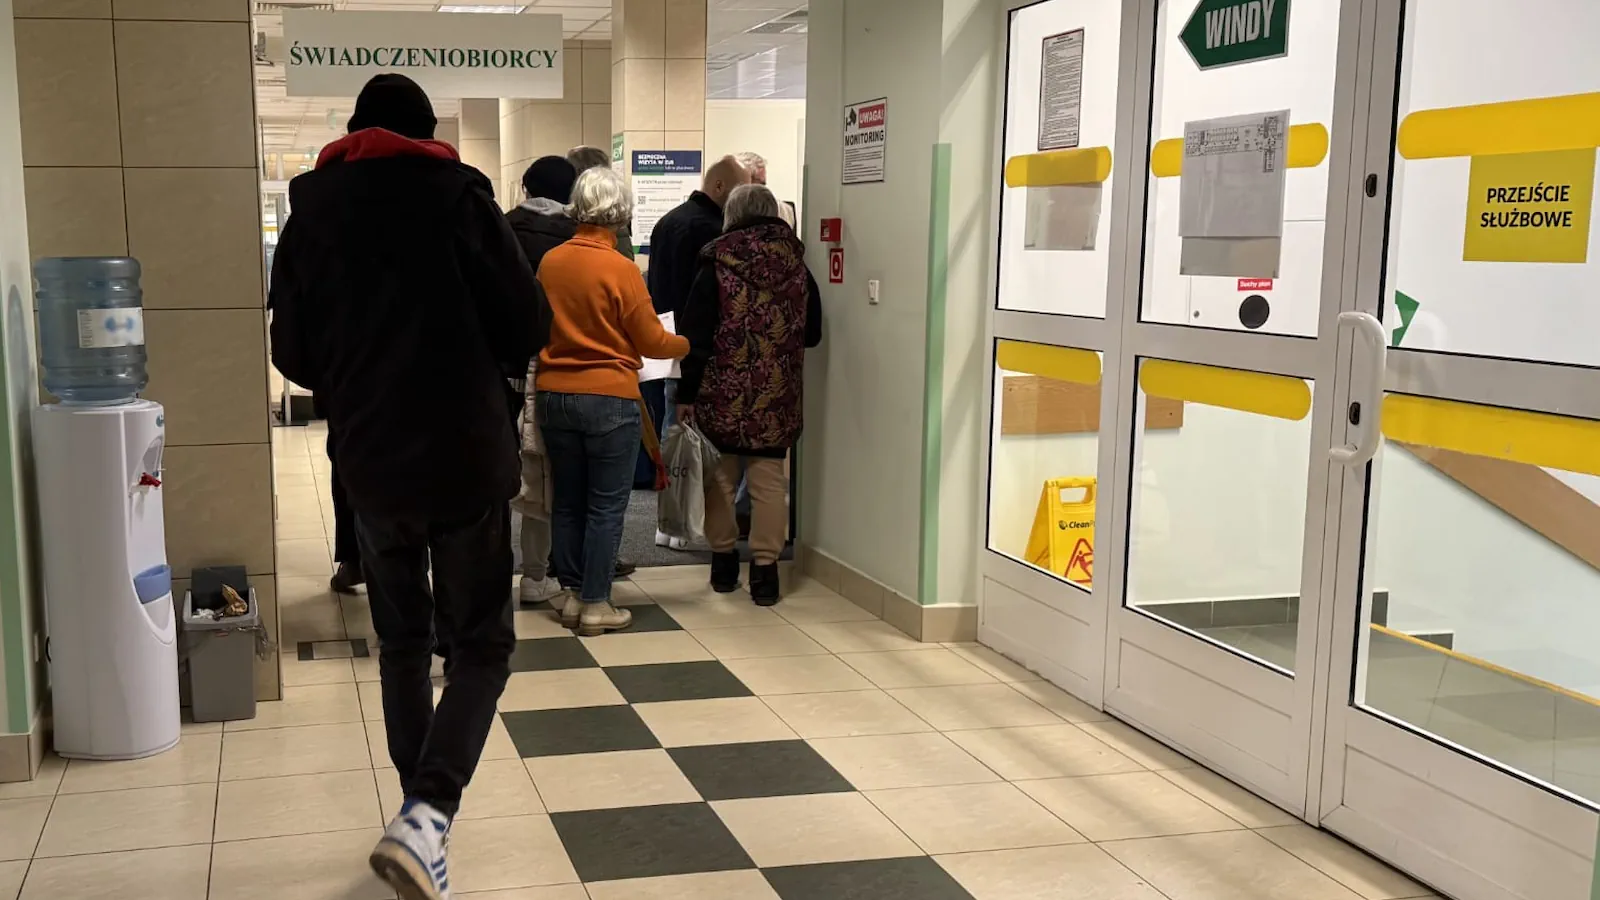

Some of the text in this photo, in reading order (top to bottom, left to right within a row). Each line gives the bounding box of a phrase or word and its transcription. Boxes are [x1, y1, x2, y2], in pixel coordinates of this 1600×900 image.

[1206, 0, 1275, 49] WINDY
[290, 41, 557, 68] ŚWIADCZENIOBIORCY
[859, 108, 884, 123] UWAGA!
[845, 130, 884, 145] MONITORING
[1487, 182, 1570, 203] PRZEJŚCIE
[1480, 208, 1572, 227] SŁUŻBOWE
